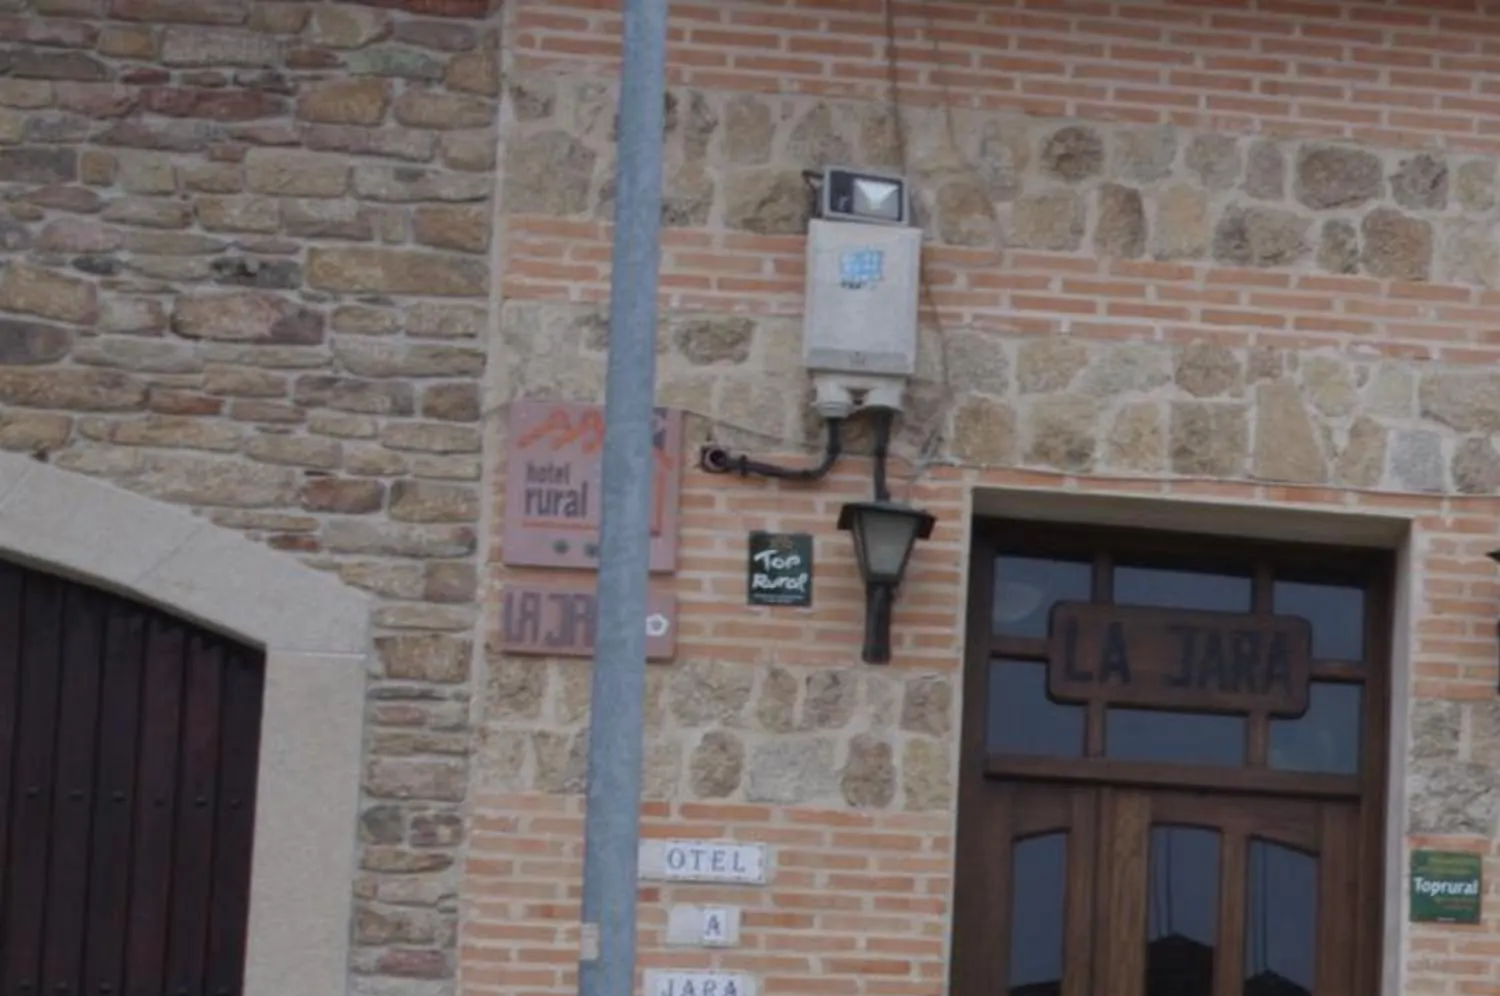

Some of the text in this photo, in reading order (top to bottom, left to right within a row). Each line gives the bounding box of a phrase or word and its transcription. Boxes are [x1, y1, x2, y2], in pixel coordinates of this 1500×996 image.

[525, 461, 571, 485] hotel
[524, 482, 588, 519] rural
[752, 573, 809, 593] Rural
[1064, 616, 1294, 695] LA JARA
[1413, 876, 1479, 897] Toprural
[703, 913, 721, 936] A
